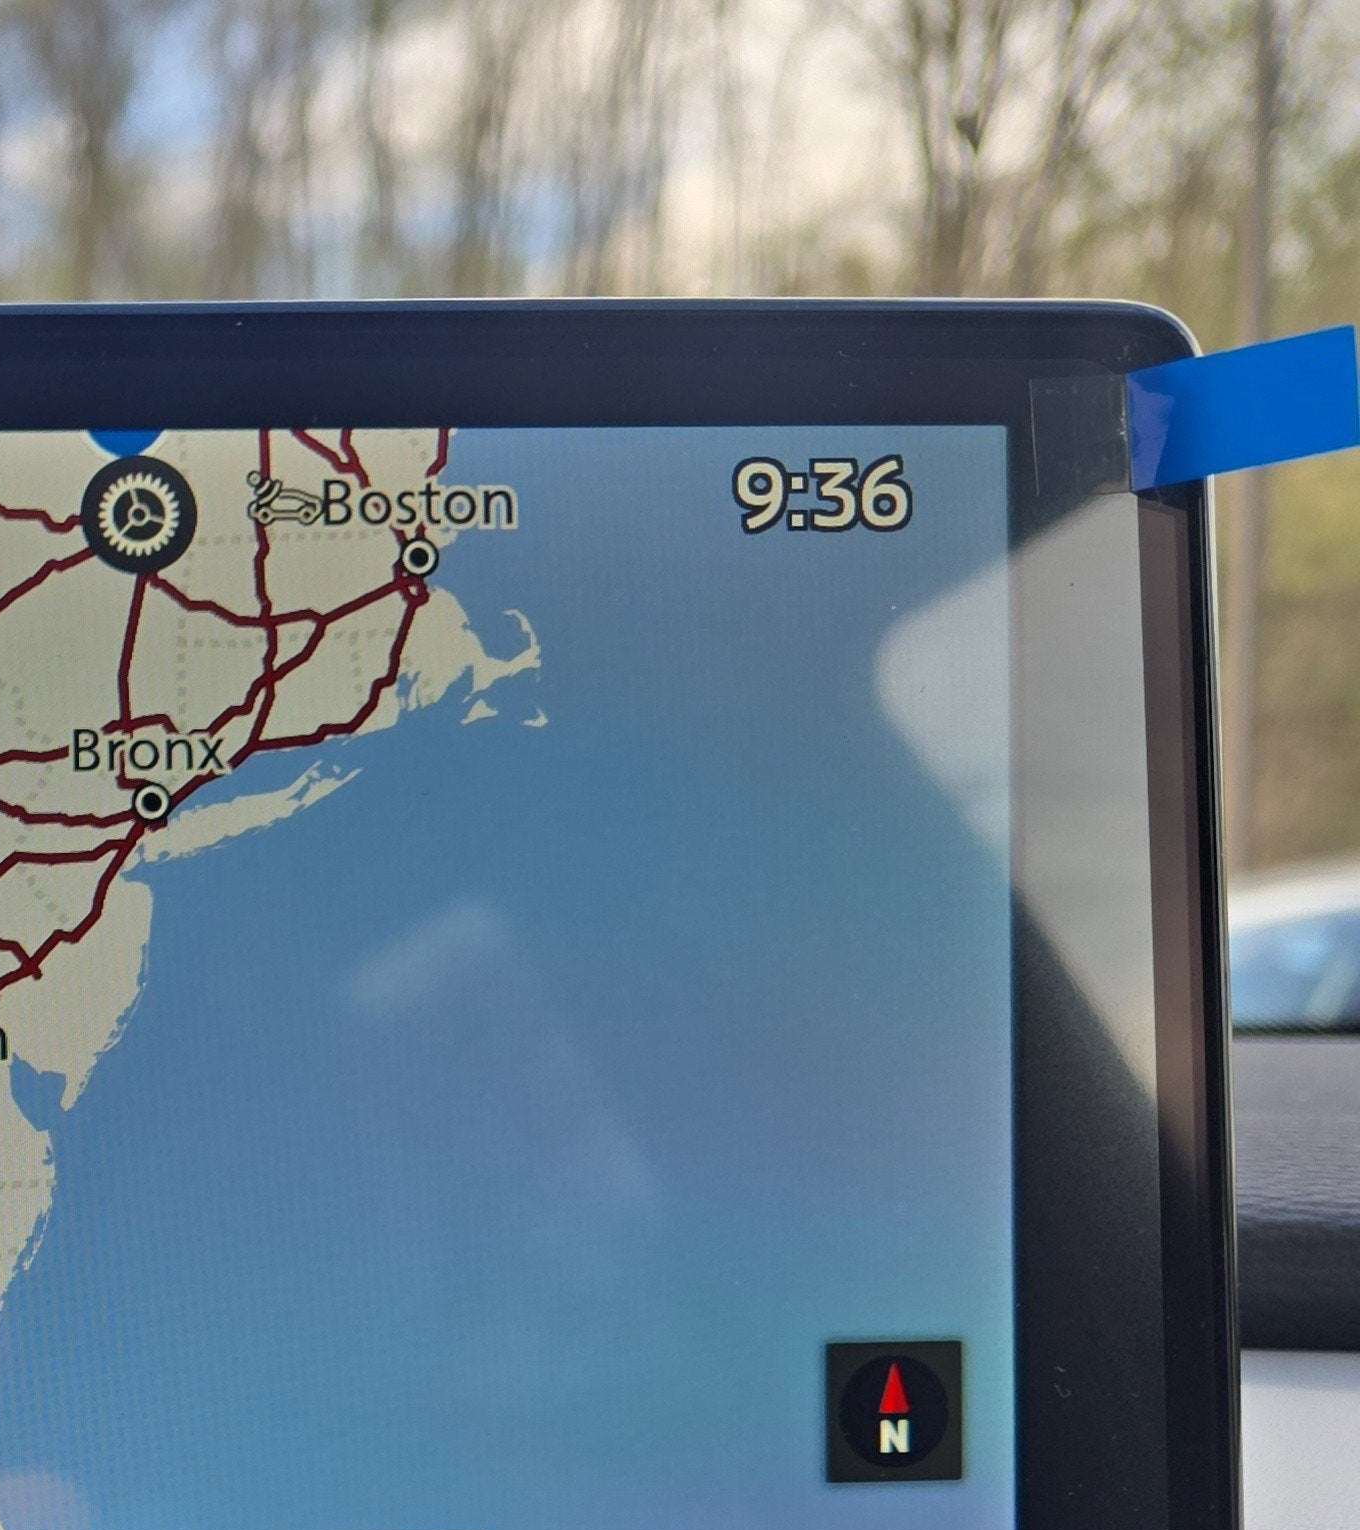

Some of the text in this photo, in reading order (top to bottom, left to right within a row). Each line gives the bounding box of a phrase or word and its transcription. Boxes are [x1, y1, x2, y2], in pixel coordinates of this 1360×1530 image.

[321, 477, 517, 529] Boston
[733, 454, 914, 532] 9:36
[72, 728, 226, 774] Bronx
[879, 1419, 910, 1454] N
